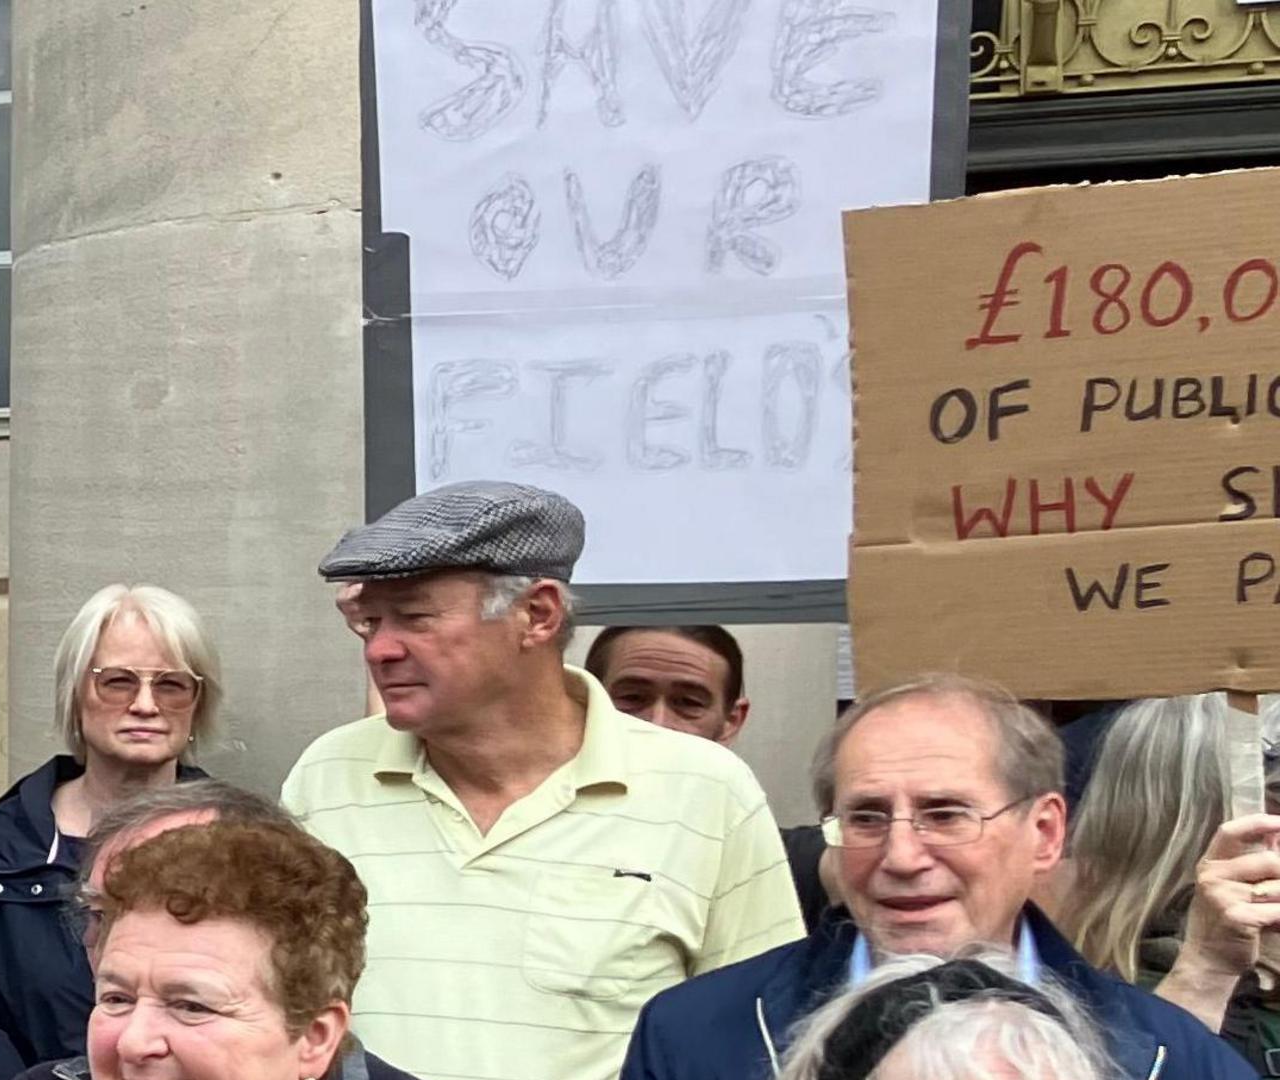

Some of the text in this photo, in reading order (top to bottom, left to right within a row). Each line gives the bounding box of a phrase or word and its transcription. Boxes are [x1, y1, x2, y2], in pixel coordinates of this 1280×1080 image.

[470, 155, 801, 281] OUR
[929, 378, 1030, 444] OF
[952, 472, 1135, 541] WHY
[1065, 563, 1170, 612] WE
